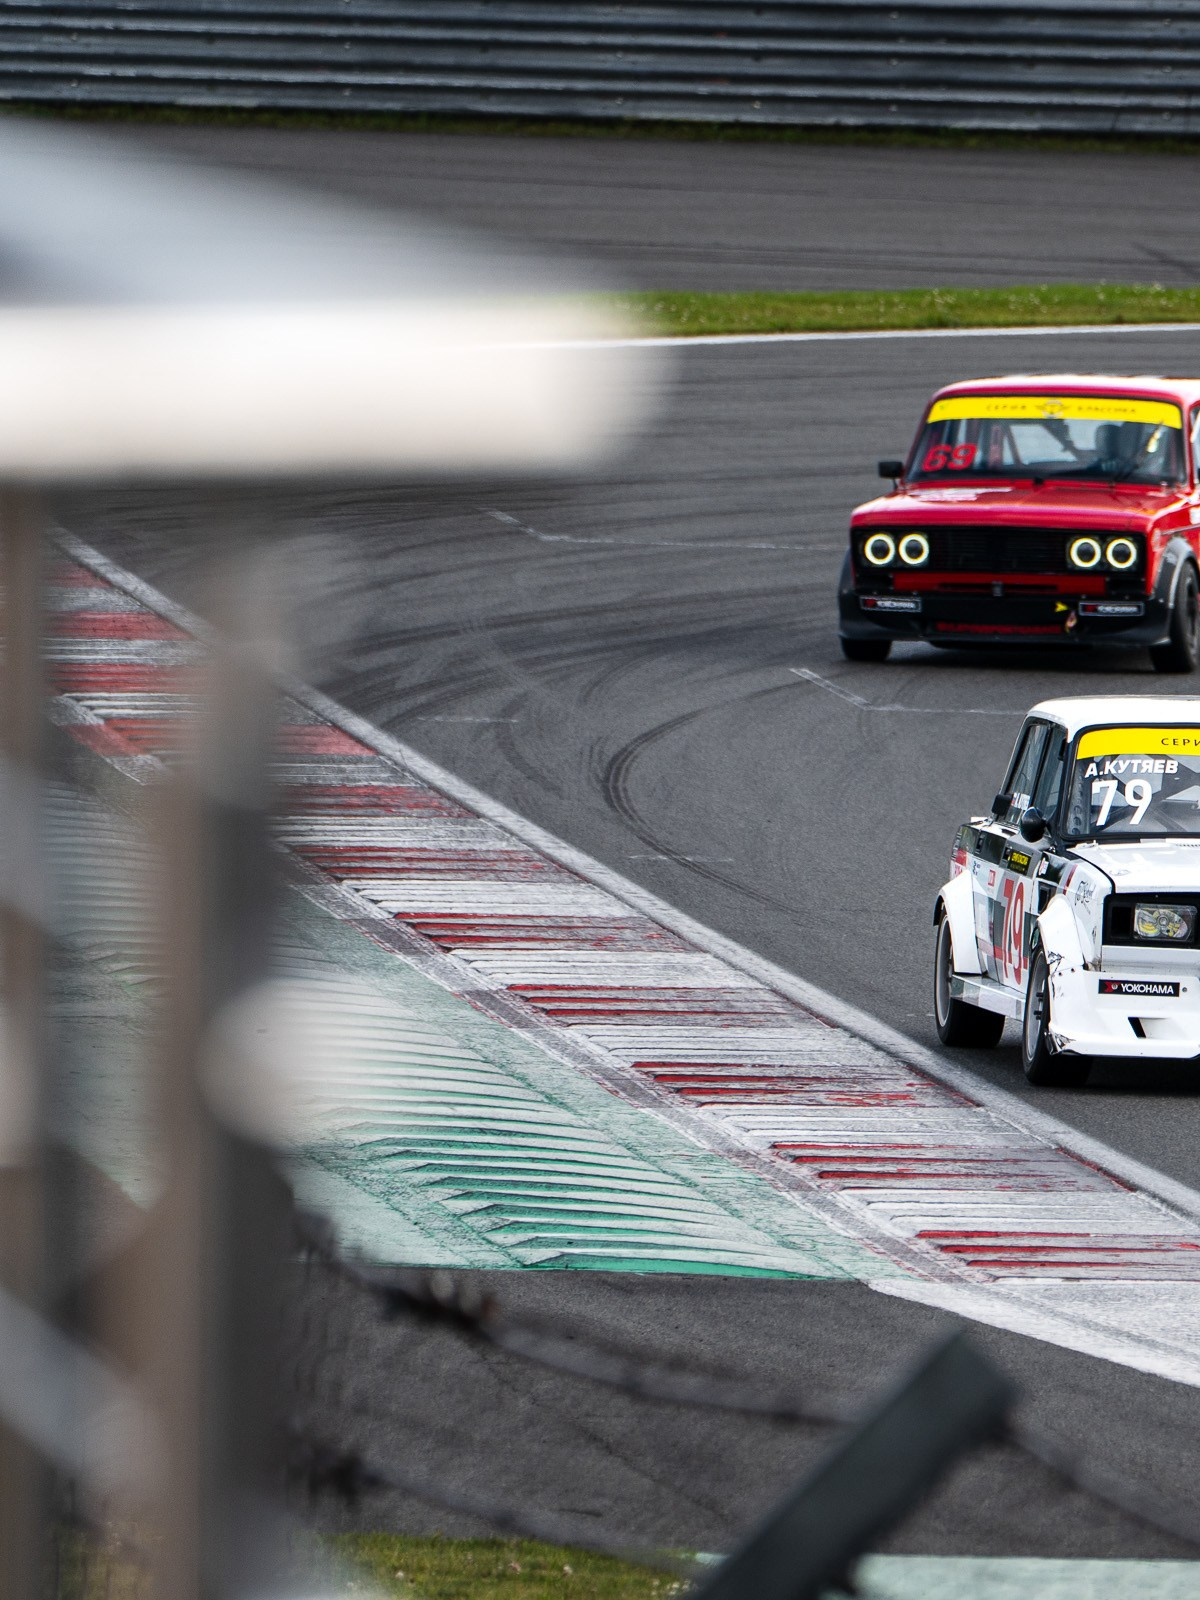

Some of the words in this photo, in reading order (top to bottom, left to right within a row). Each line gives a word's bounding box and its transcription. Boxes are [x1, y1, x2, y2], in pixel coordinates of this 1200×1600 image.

[922, 443, 977, 472] 69
[1085, 759, 1179, 778] А.КУТЯЕВ
[1091, 778, 1153, 826] 79
[1003, 878, 1024, 985] 79
[1121, 983, 1174, 994] YOKOHAMA
